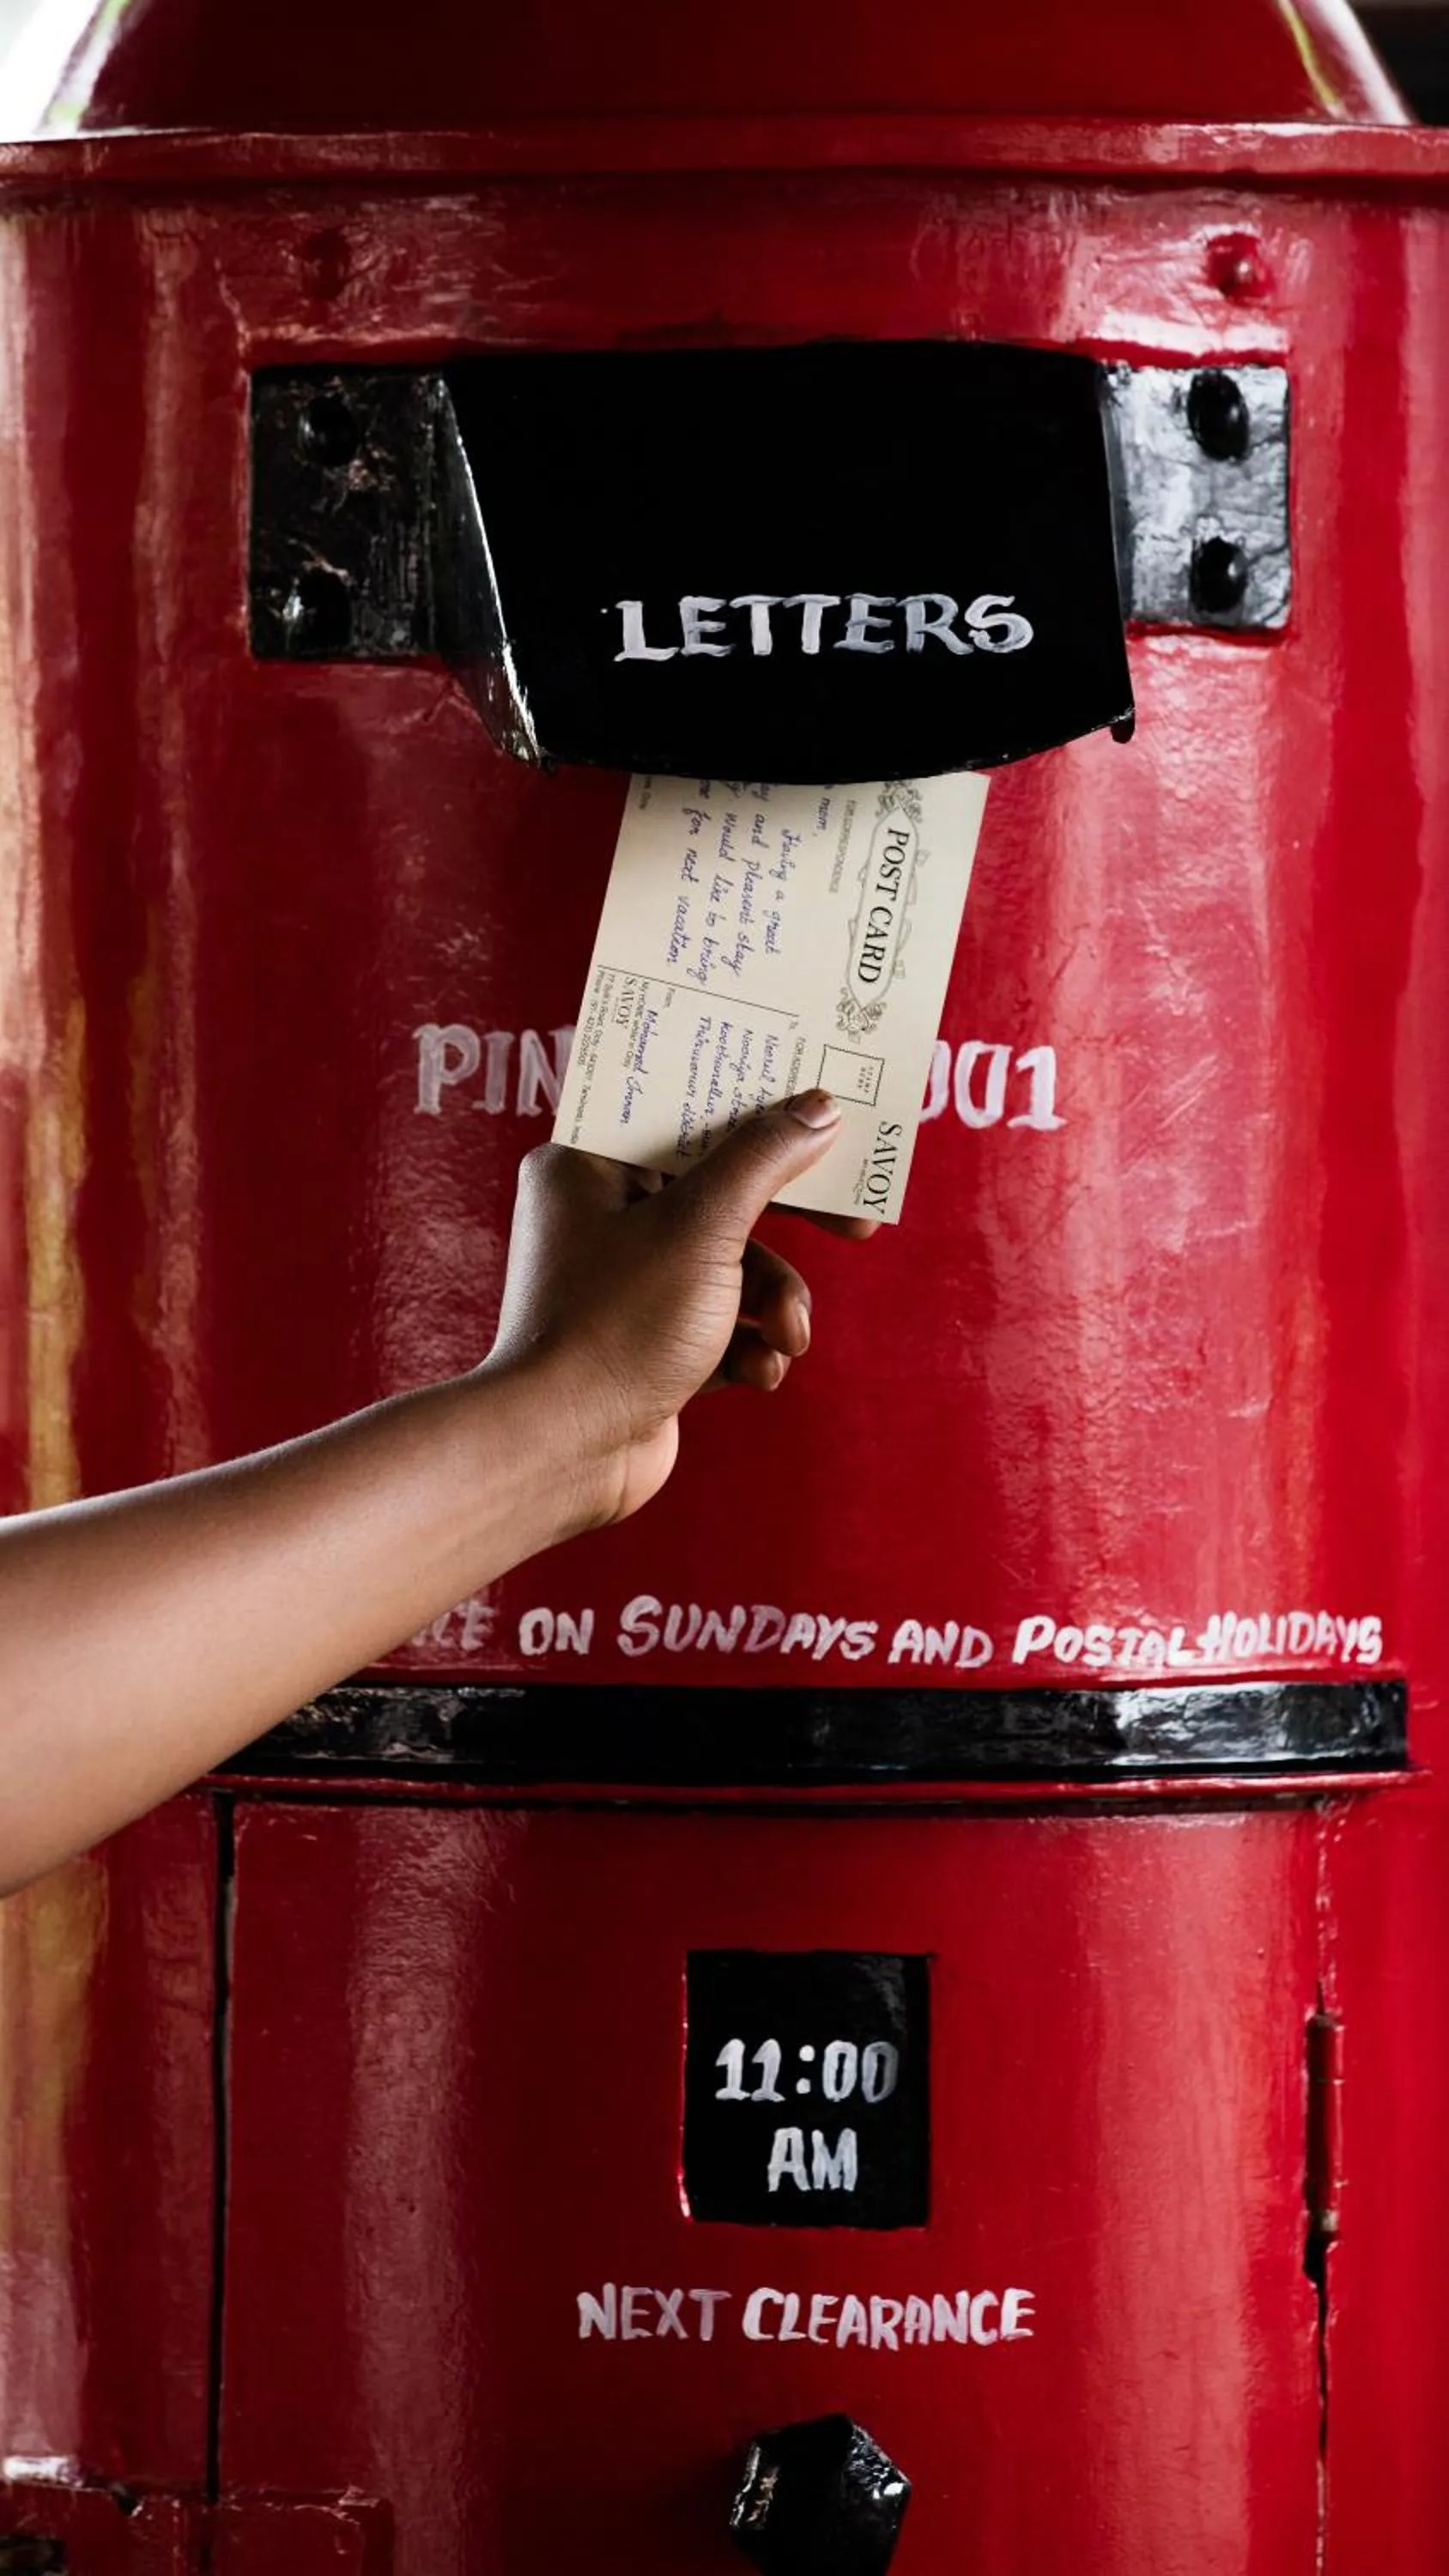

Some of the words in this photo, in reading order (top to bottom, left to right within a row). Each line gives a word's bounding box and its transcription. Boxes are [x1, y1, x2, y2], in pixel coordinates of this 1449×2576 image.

[612, 592, 1034, 662] LETTERS
[751, 814, 768, 847] and
[874, 827, 909, 902] POST
[857, 904, 893, 985] CARD
[615, 975, 637, 1029] SAVOY
[412, 1023, 578, 1116] PIN
[861, 1120, 902, 1214] SAVOY
[518, 1607, 594, 1656] ON
[616, 1594, 879, 1661] SUNDAYS
[888, 1619, 995, 1669] AND
[1011, 1614, 1198, 1668] POSTAL
[1197, 1610, 1383, 1664] HOLIDAYS
[714, 2038, 898, 2104] 11:00
[767, 2126, 858, 2192] AM
[576, 2281, 732, 2342] NEXT
[742, 2286, 1037, 2351] CLEARANCE
